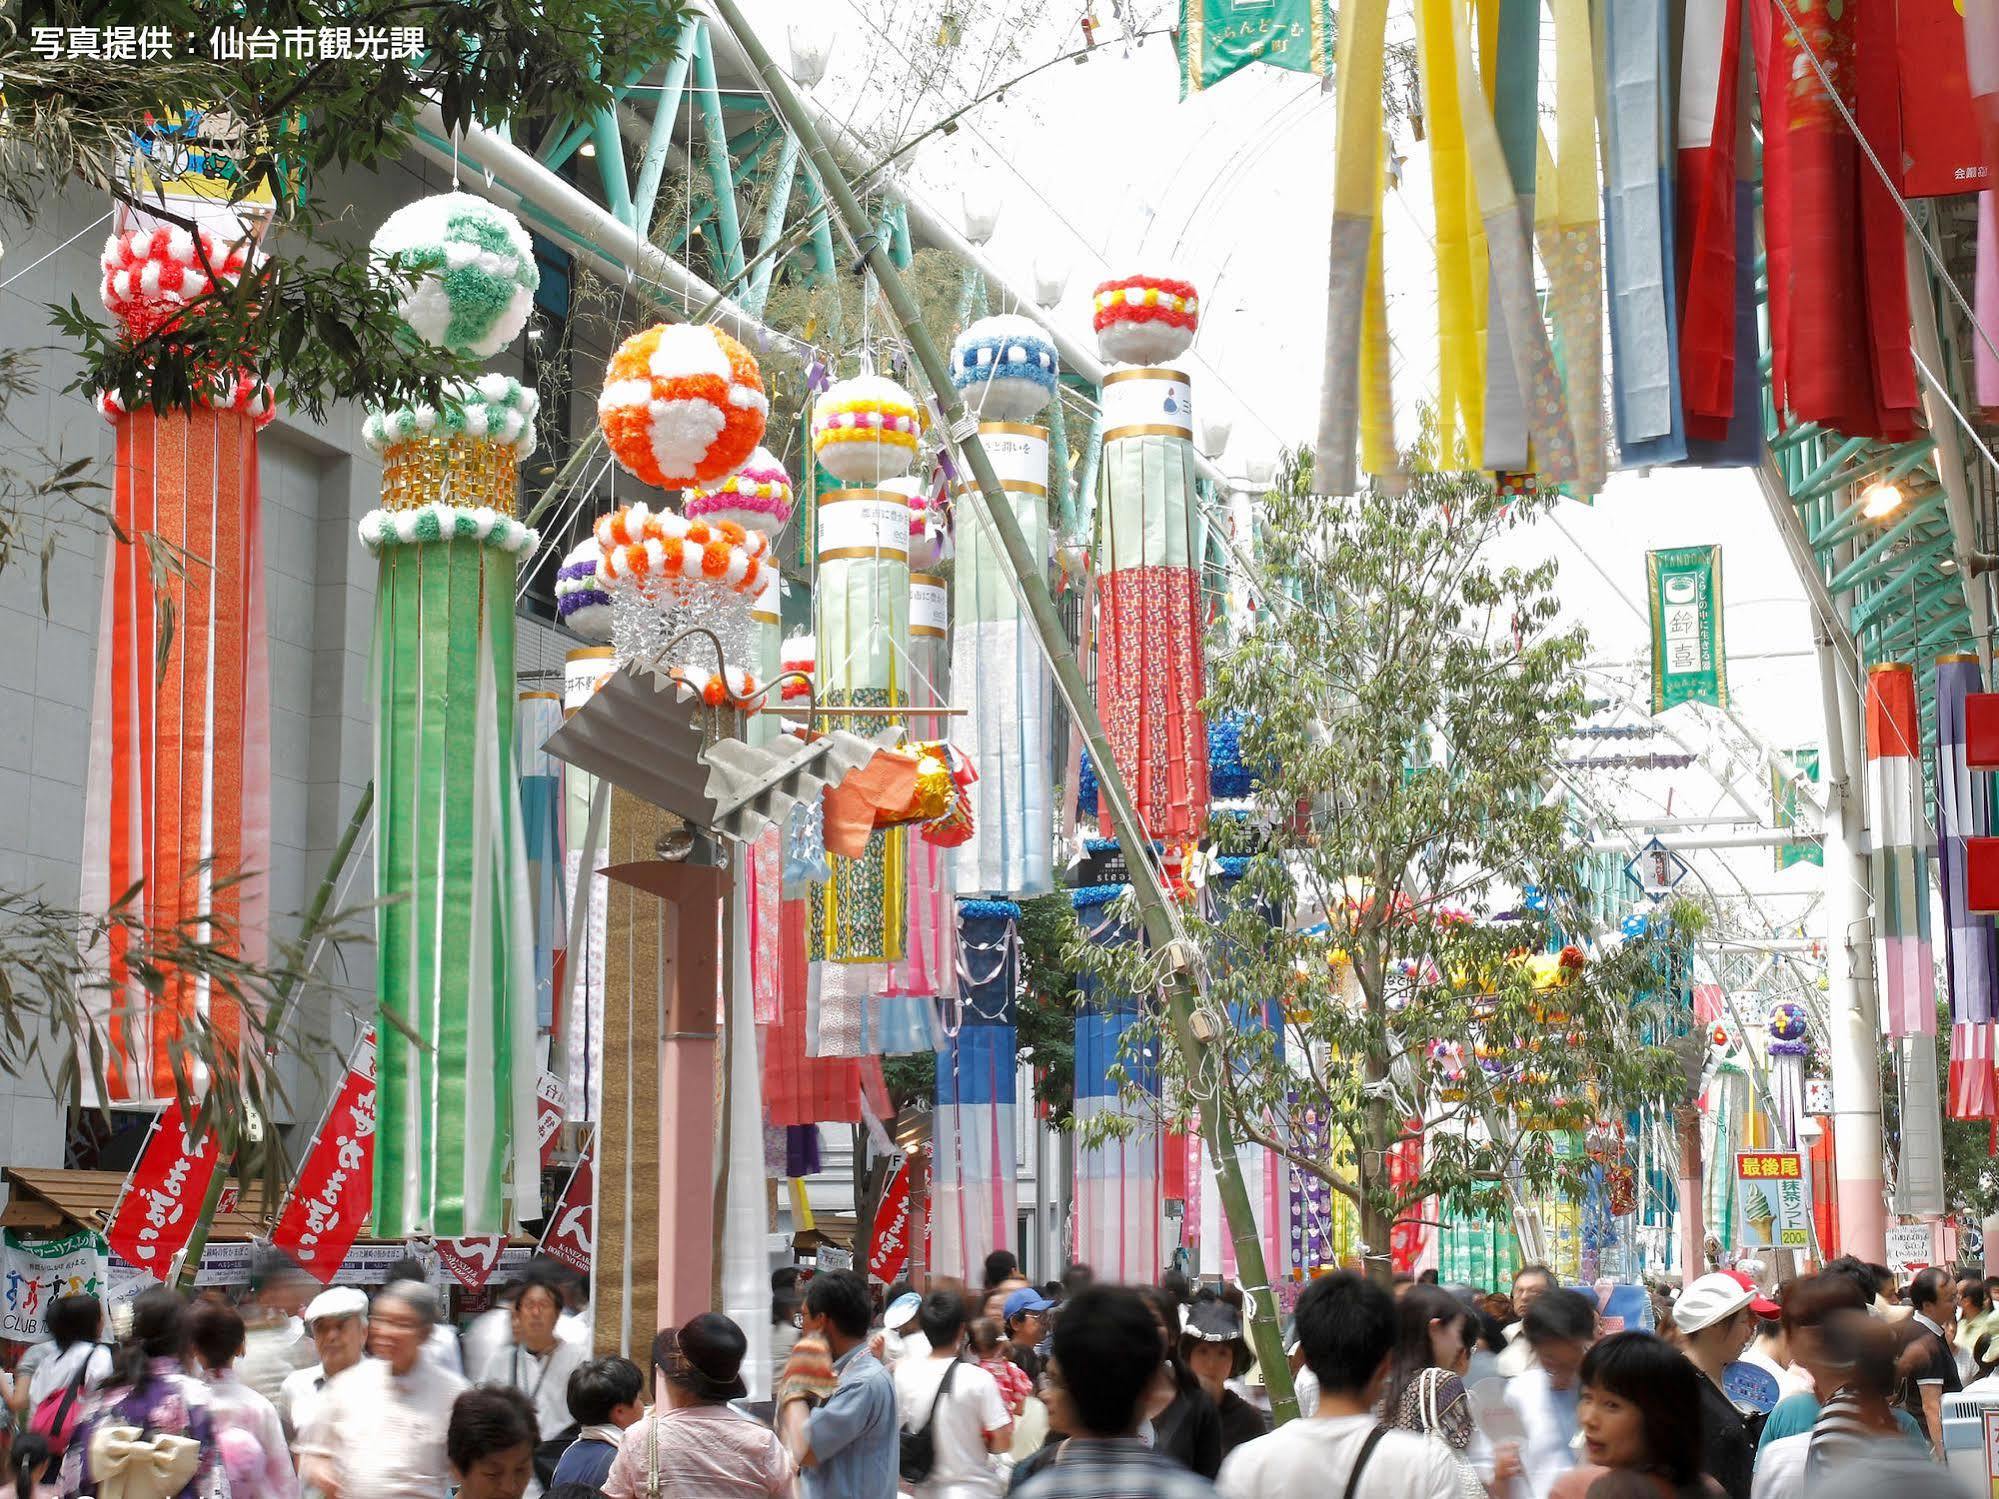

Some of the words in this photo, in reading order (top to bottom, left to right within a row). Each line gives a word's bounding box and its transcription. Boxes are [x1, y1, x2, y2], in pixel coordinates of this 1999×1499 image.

[1669, 610, 1697, 669] 鈴喜
[1742, 1157, 1799, 1177] 最後尾
[1782, 1181, 1802, 1228] 抹茶ソフト
[3, 1314, 37, 1334] CLUB
